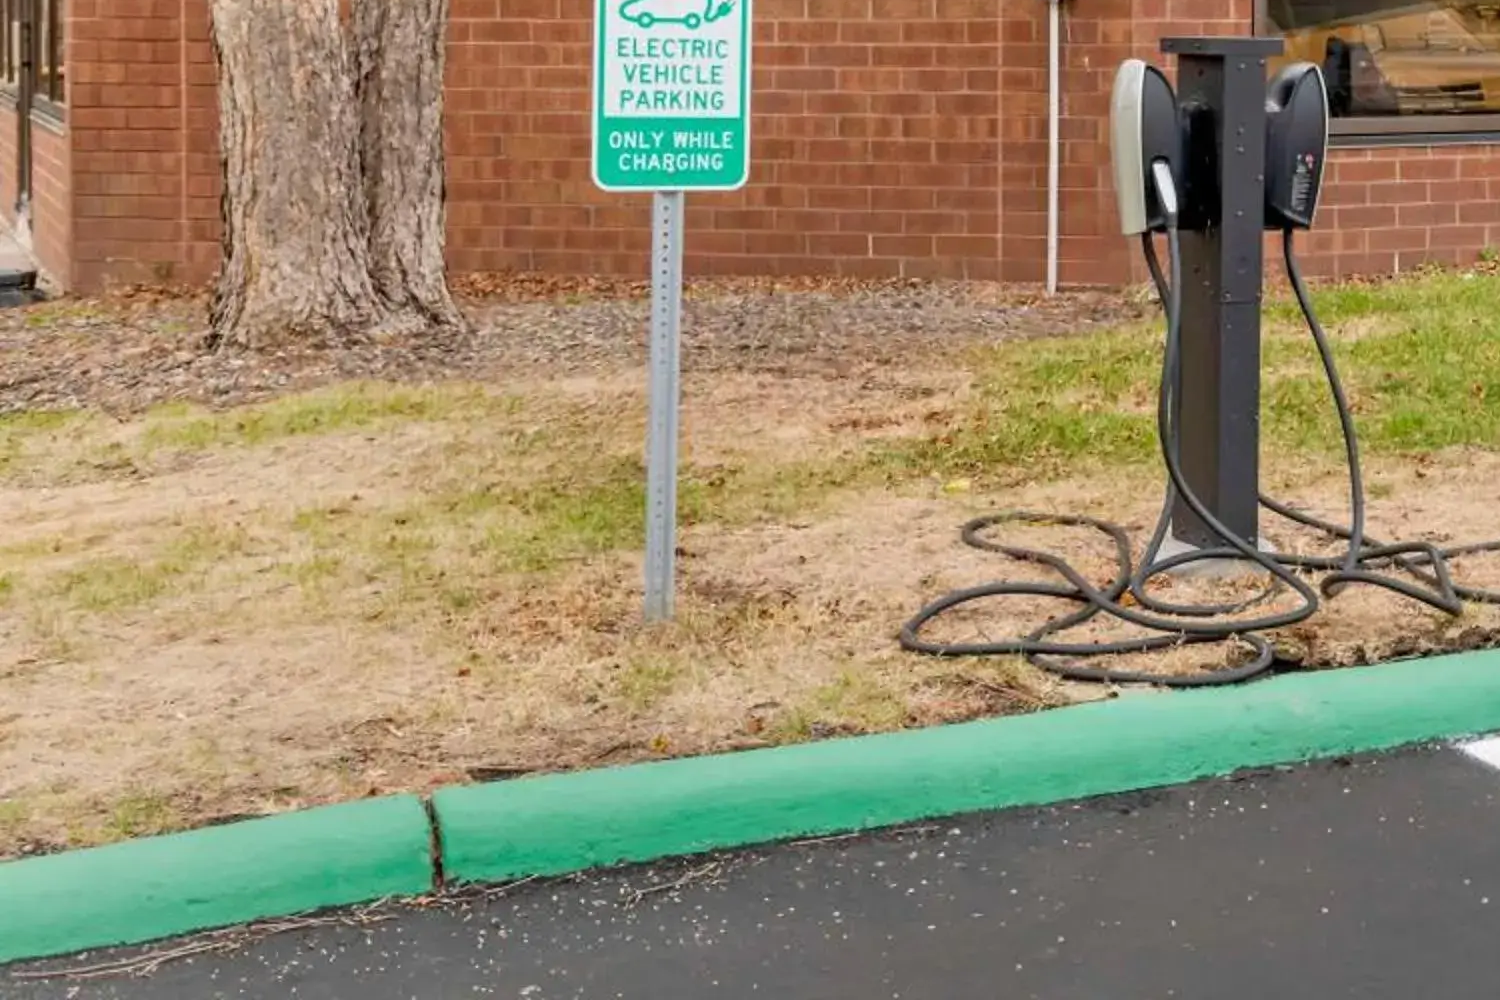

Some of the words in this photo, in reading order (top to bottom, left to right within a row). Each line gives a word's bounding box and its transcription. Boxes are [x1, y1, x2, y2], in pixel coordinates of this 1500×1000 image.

[617, 37, 728, 59] ELECTRIC
[623, 64, 723, 84] VEHICLE
[619, 90, 725, 110] PARKING
[609, 131, 664, 149] ONLY
[673, 132, 734, 150] WHILE
[619, 153, 723, 172] CHARGING
